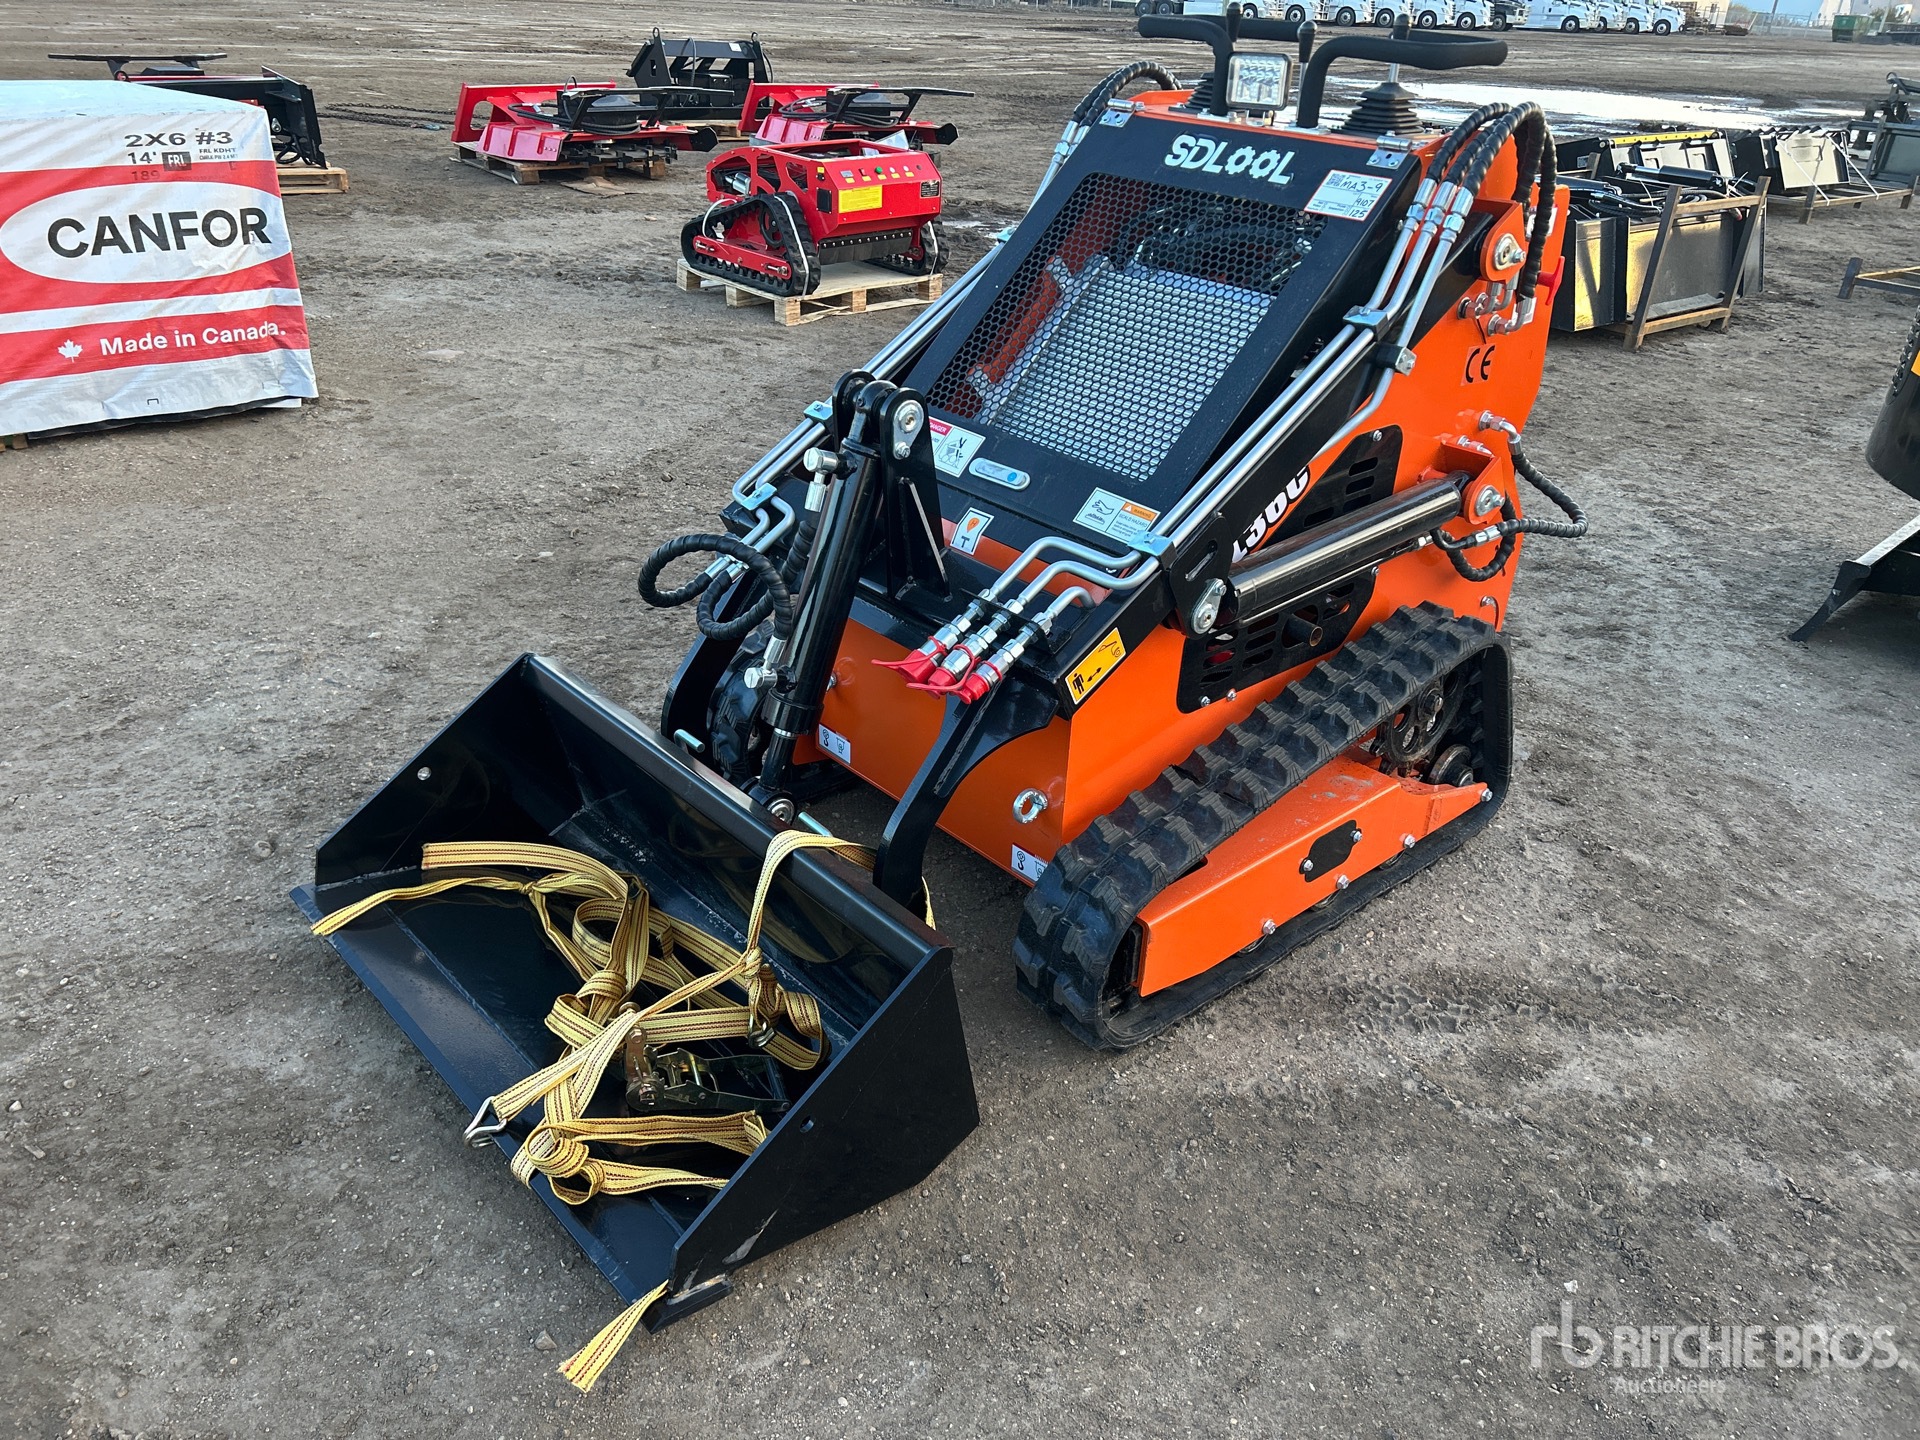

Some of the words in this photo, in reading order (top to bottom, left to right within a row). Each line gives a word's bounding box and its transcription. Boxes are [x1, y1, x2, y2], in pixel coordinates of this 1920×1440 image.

[124, 133, 187, 147] 2X6
[195, 131, 234, 145] #3
[167, 154, 187, 168] FRL
[1164, 134, 1295, 185] SDLOOL
[1348, 209, 1368, 218] 125
[48, 207, 272, 259] CANFOR
[100, 334, 168, 356] Made
[174, 328, 196, 347] in
[202, 320, 287, 345] Canada.
